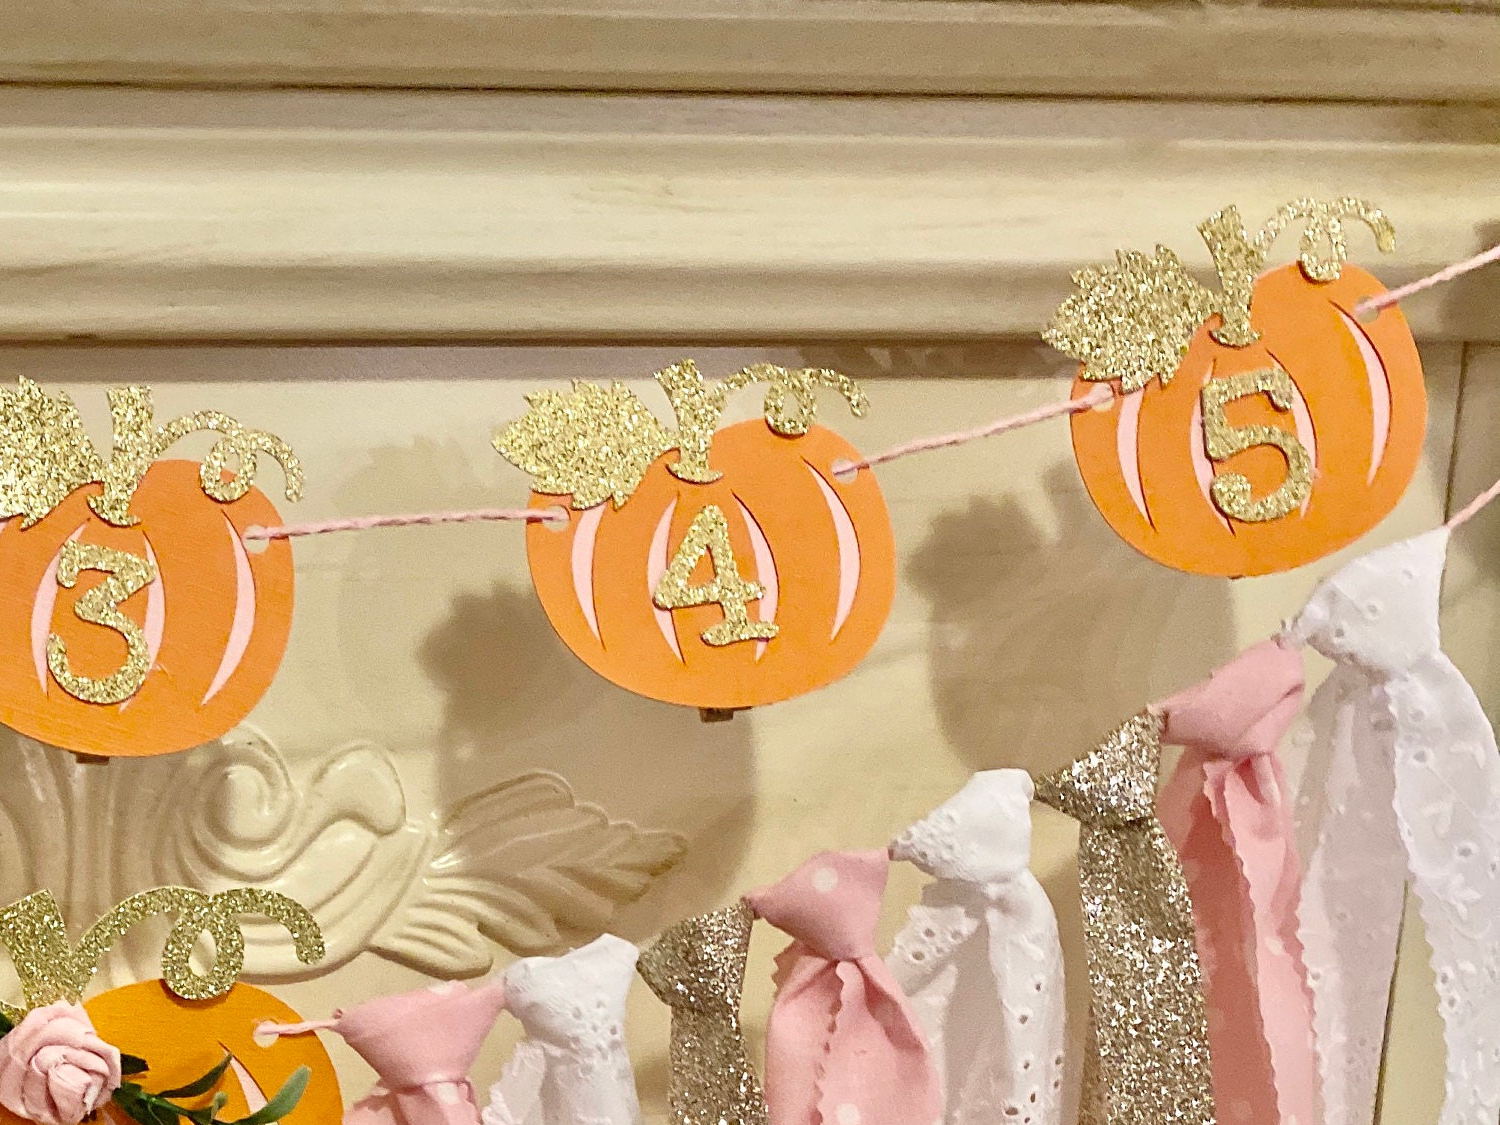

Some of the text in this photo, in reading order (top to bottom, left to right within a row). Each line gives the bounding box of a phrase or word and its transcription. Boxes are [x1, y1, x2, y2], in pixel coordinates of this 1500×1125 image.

[1201, 365, 1313, 522] 5
[47, 540, 156, 703] 3
[653, 504, 778, 646] 4
